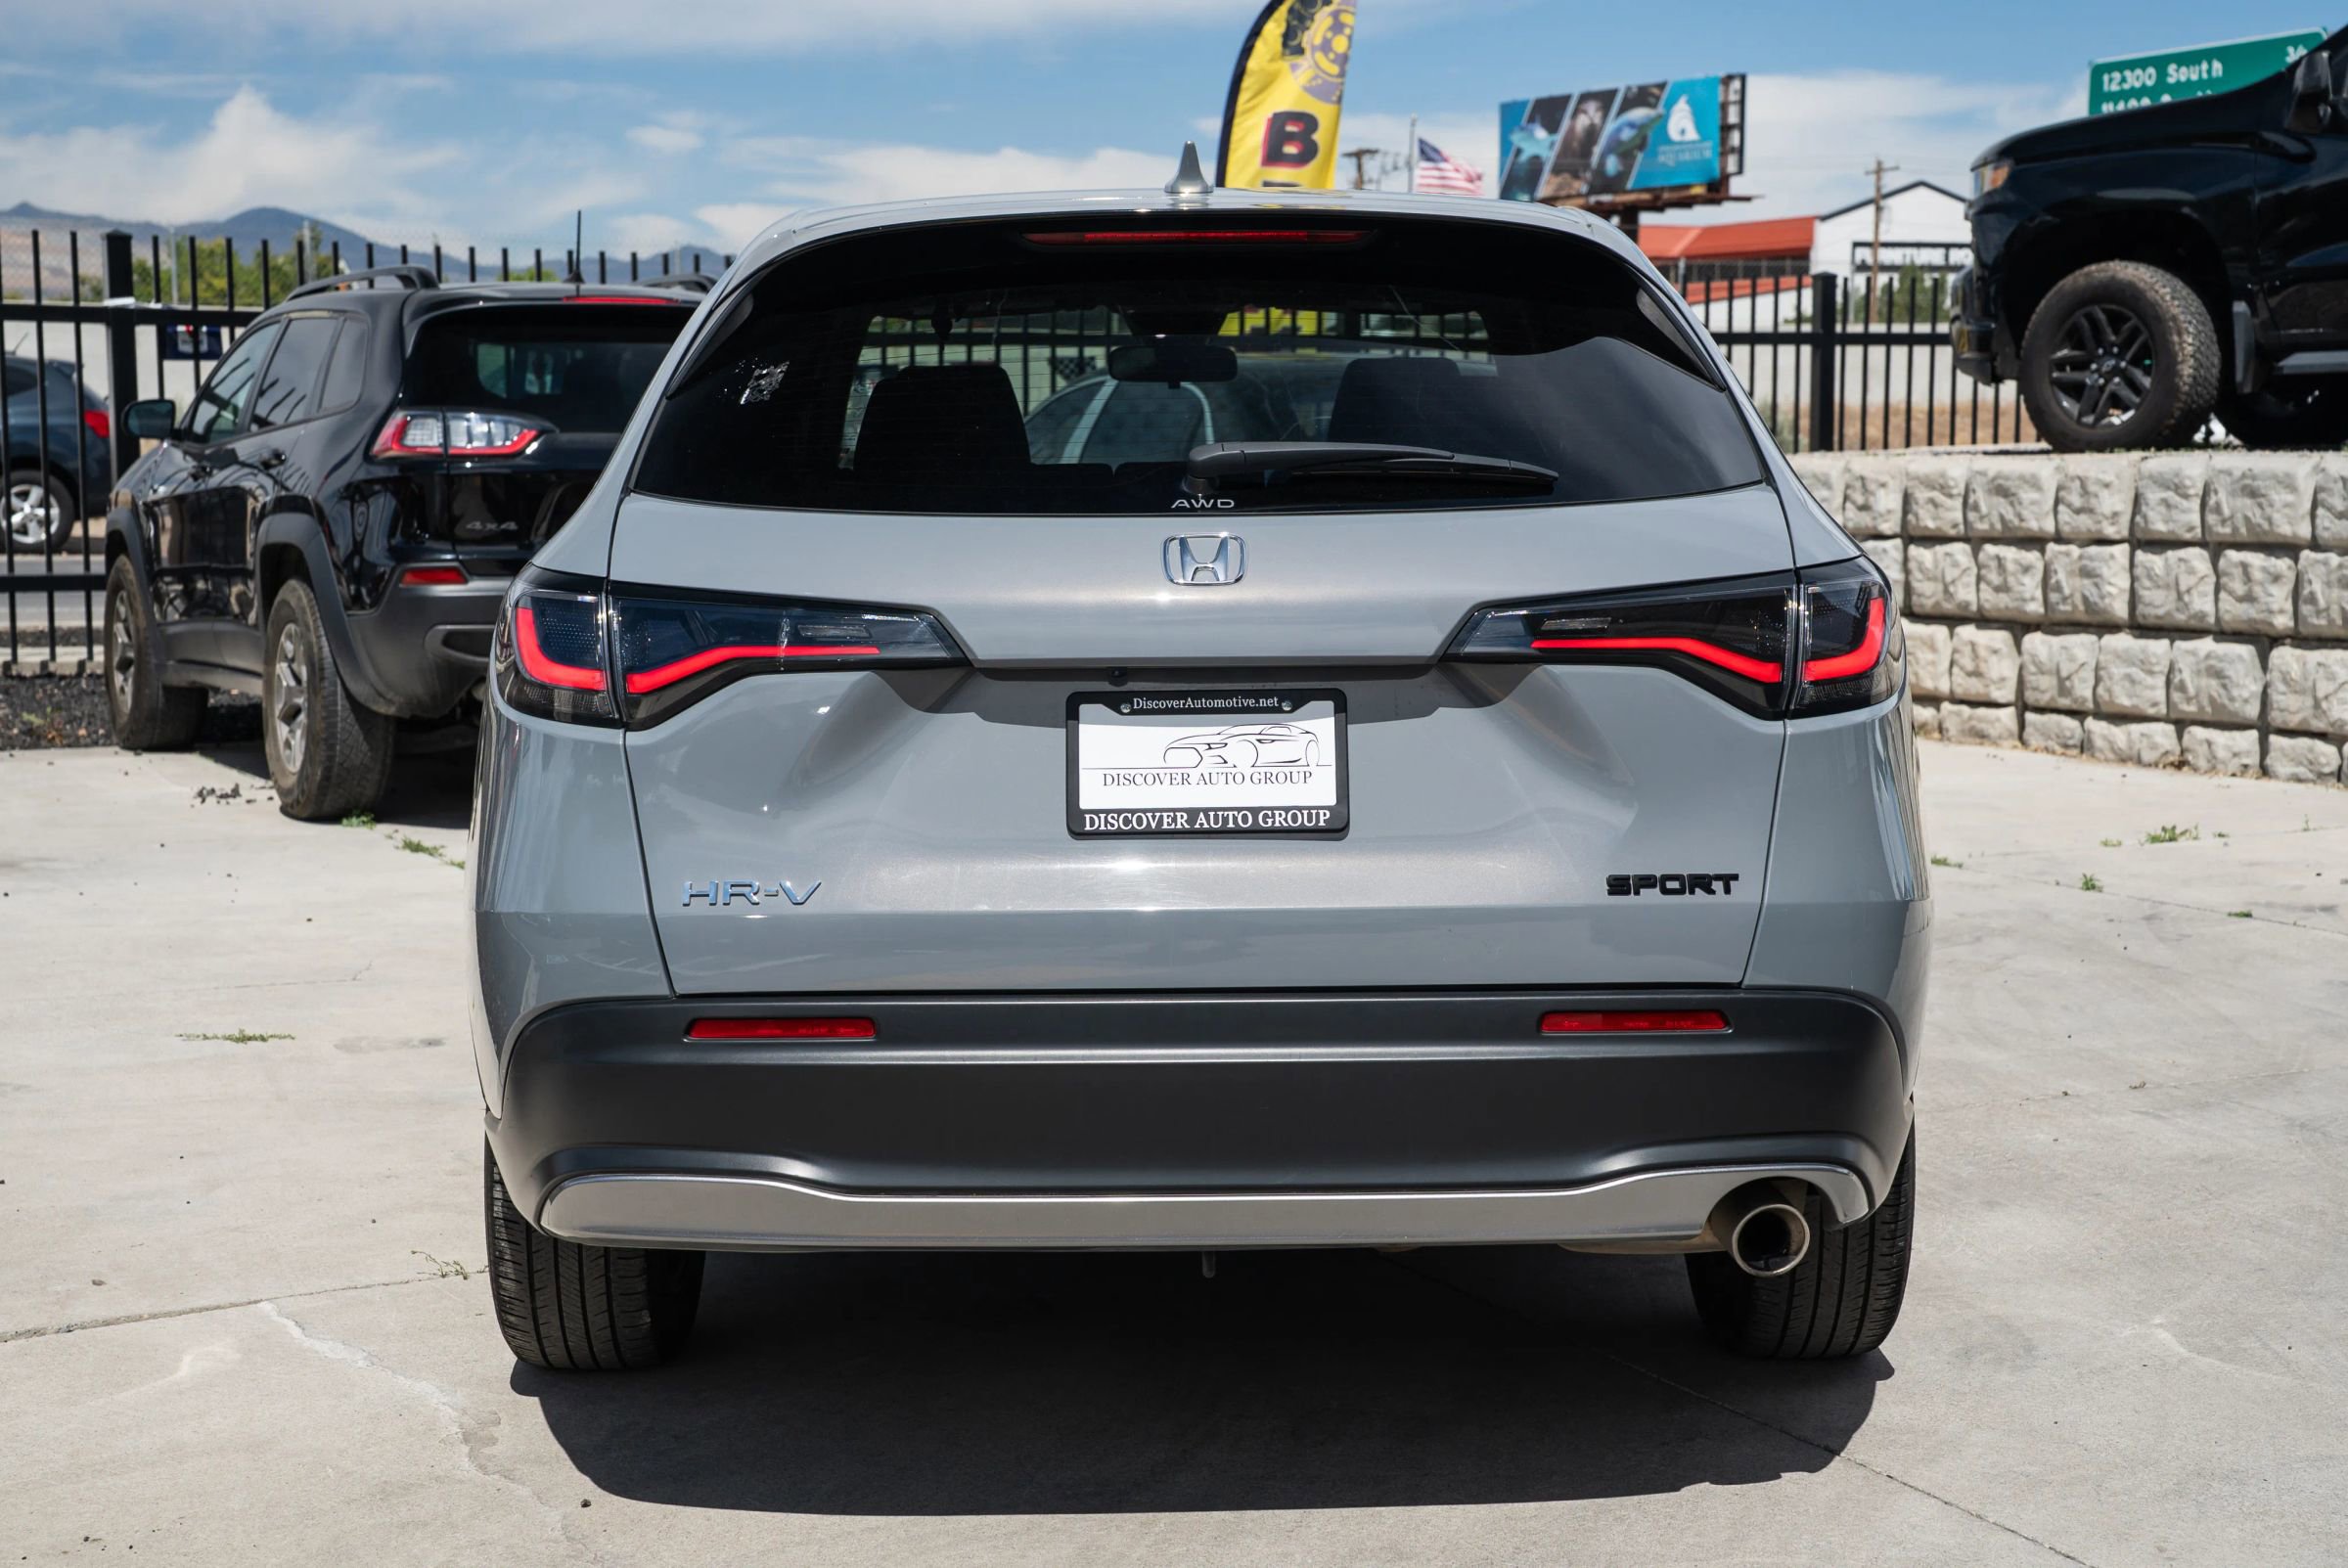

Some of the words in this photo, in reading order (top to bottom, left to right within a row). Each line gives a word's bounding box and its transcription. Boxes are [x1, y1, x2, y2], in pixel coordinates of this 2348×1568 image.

[2101, 67, 2157, 92] 12300
[2166, 59, 2223, 84] South
[1171, 499, 1235, 509] AWD
[1133, 695, 1279, 710] DiscoverAutomotive.net
[1103, 772, 1192, 786] DISCOVER
[1197, 771, 1245, 785] AUTO
[1250, 770, 1313, 784] GROUP
[1084, 812, 1191, 830] DISCOVER
[1195, 811, 1253, 829] AUTO
[1258, 809, 1331, 828] GROUP
[682, 880, 822, 907] HR-V
[1606, 873, 1739, 896] SPORT
